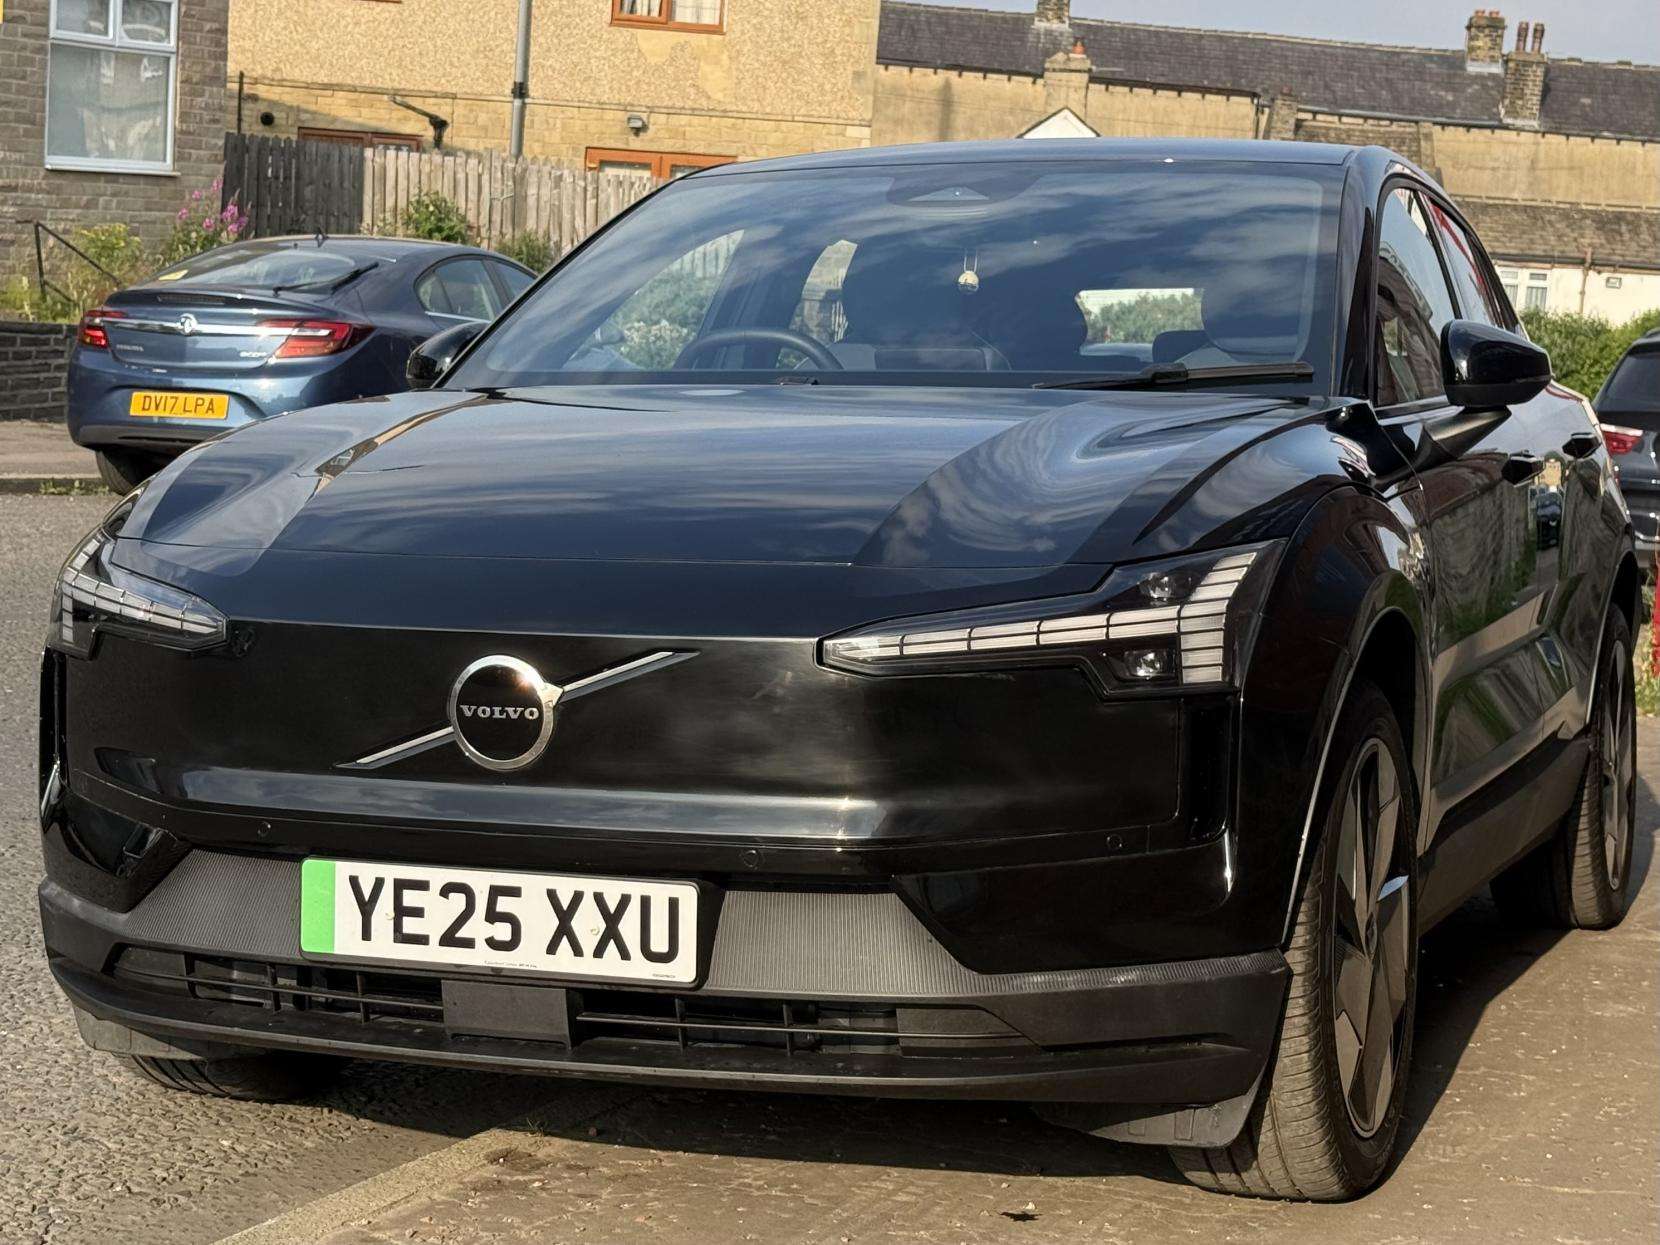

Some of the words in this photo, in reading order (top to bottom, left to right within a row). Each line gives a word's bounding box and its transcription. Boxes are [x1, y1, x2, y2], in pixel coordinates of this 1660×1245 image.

[141, 395, 178, 414] DV17
[183, 396, 215, 414] LPA
[459, 704, 540, 720] VOLVO
[348, 875, 522, 952] YE25
[545, 888, 680, 964] XXU
